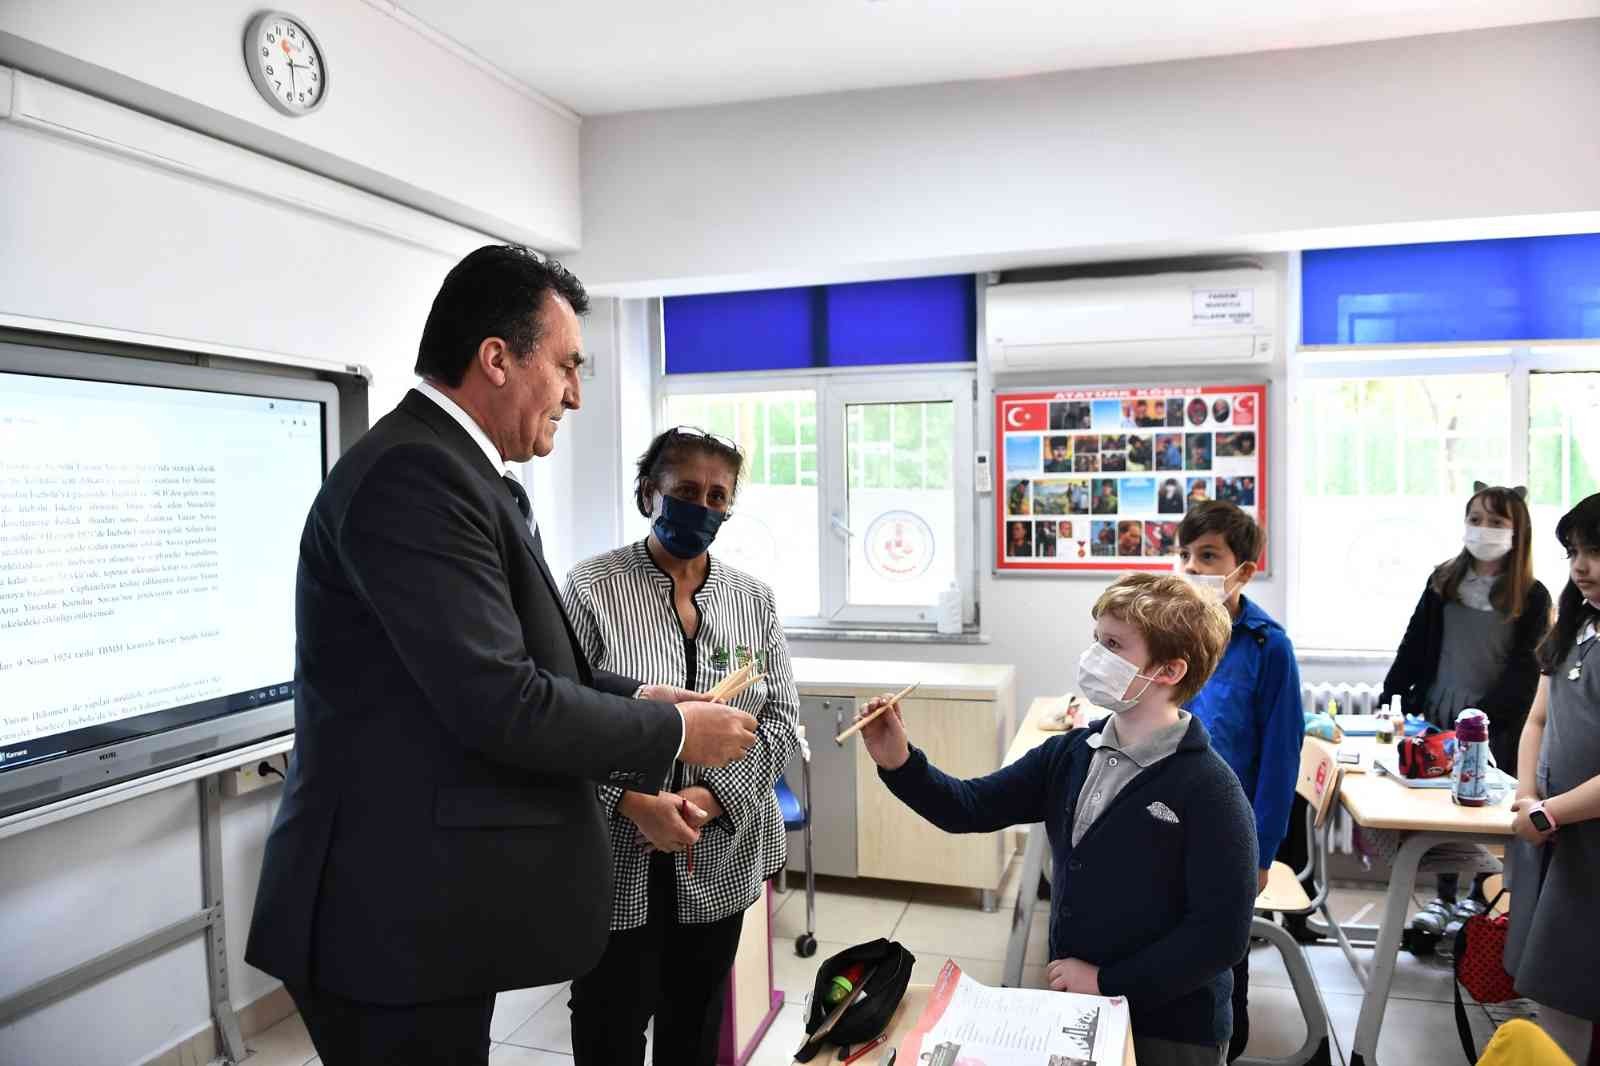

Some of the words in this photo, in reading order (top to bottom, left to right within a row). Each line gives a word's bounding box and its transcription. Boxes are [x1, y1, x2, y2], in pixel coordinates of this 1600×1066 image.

[275, 25, 282, 36] 11
[287, 25, 296, 39] 12
[266, 32, 275, 44] 10
[262, 47, 269, 57] 9
[308, 56, 314, 66] 2
[266, 65, 274, 75] 8
[312, 72, 317, 82] 3
[275, 80, 282, 91] 7
[307, 87, 313, 96] 4
[286, 91, 293, 103] 6
[298, 92, 305, 102] 5
